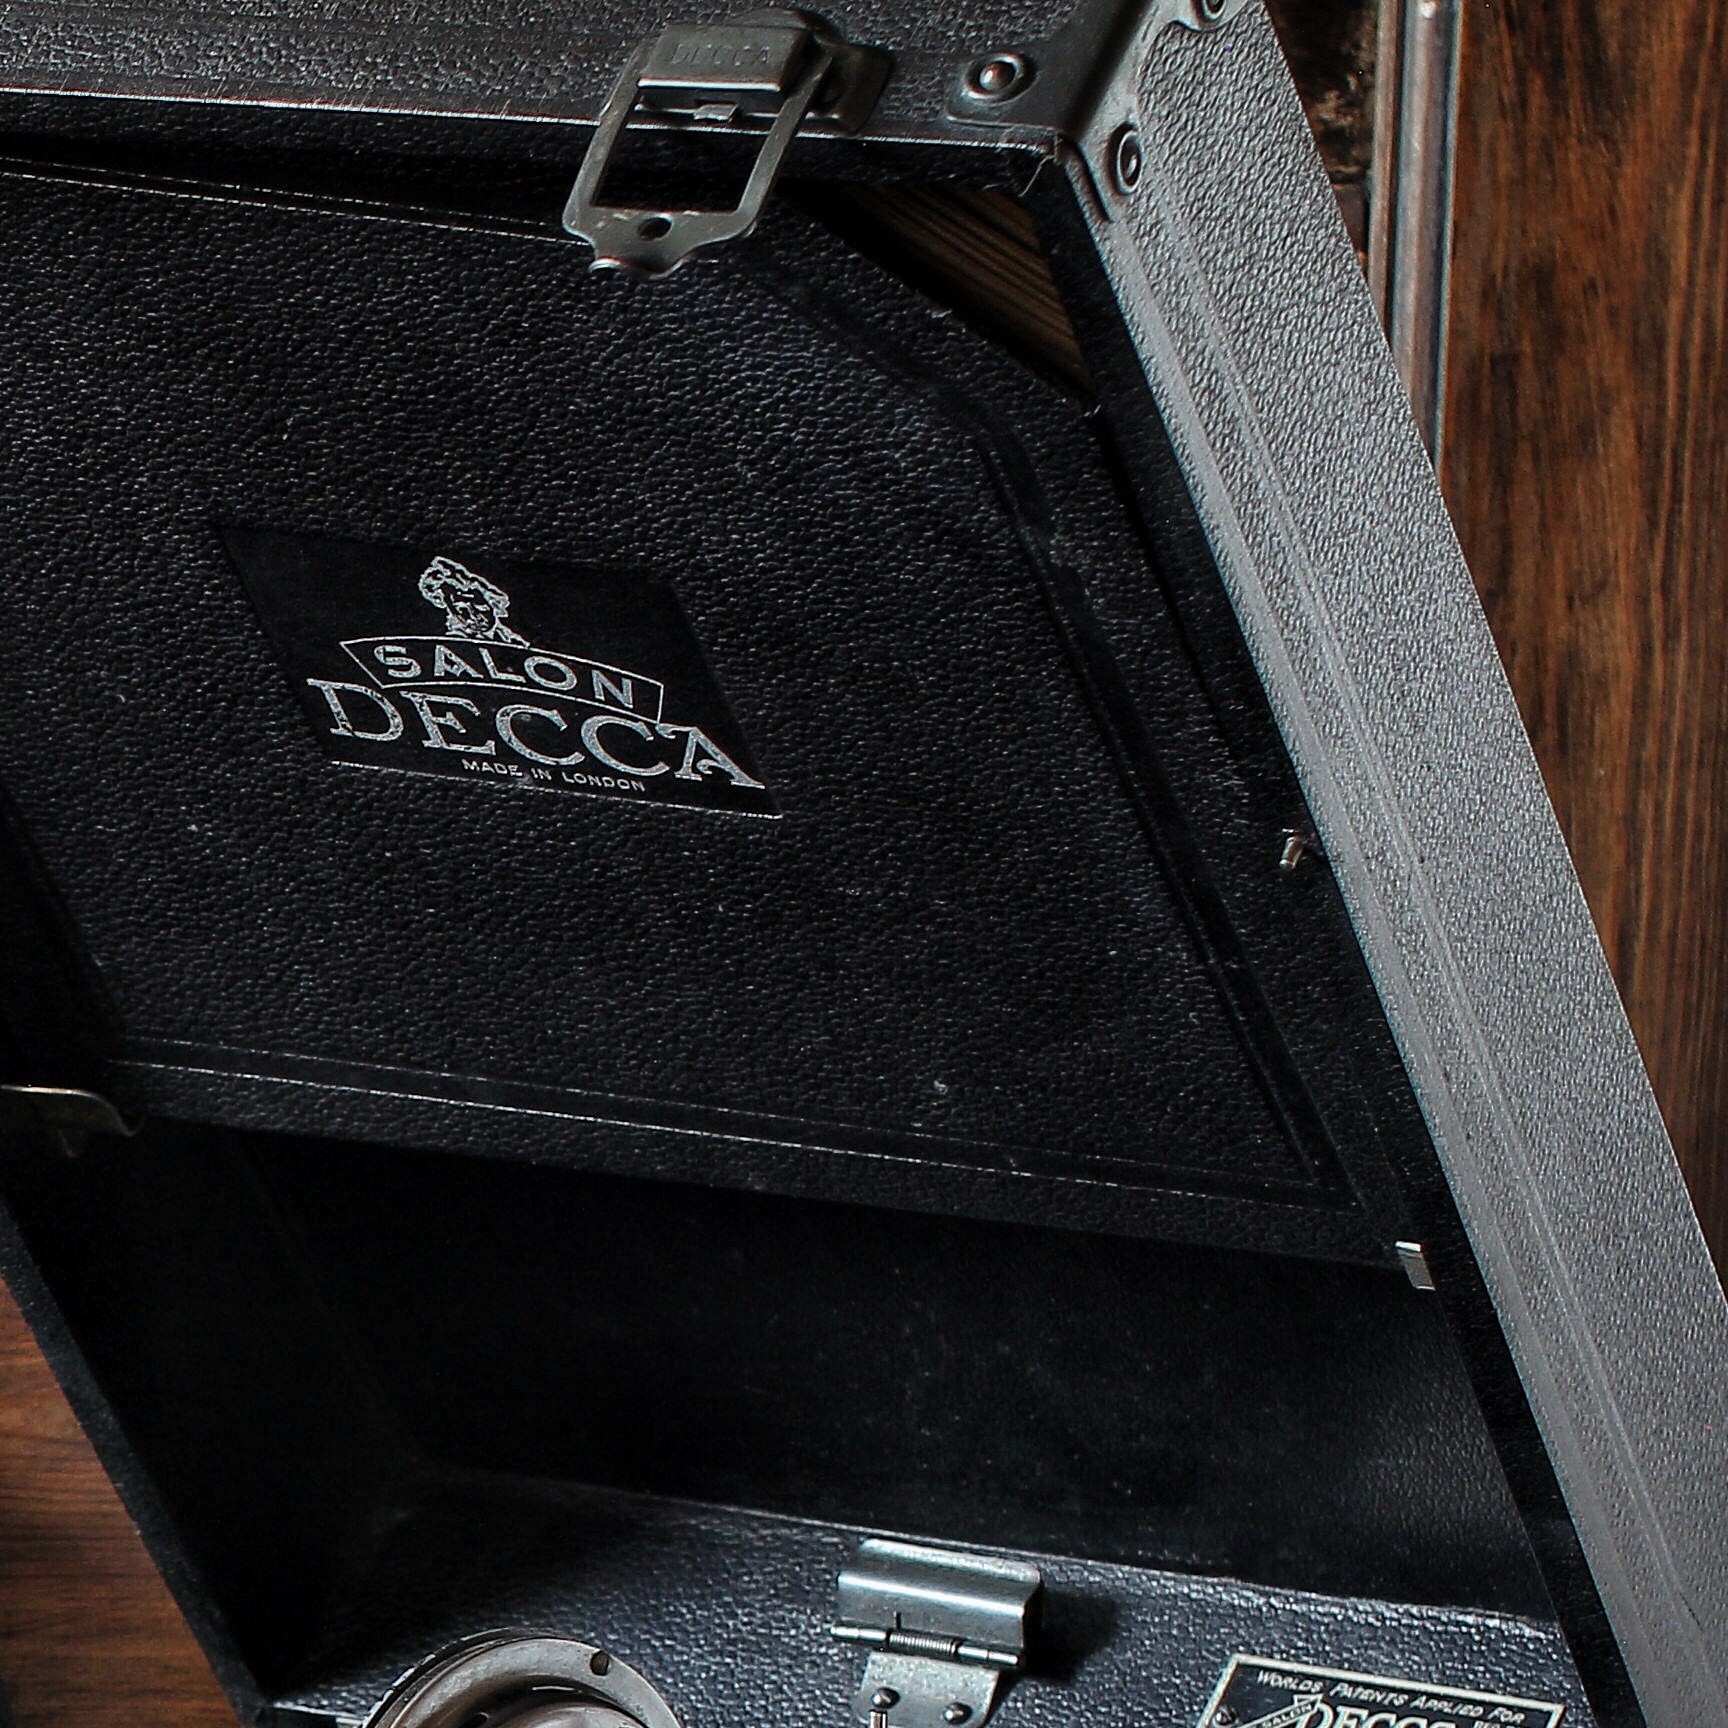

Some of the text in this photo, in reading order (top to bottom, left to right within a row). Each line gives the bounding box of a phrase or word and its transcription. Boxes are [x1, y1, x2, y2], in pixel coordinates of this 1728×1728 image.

[374, 644, 635, 709] SALON
[307, 677, 766, 790] DECCA
[461, 757, 646, 794] MADE IN LONDON
[1329, 1680, 1410, 1707] PATENTS
[1410, 1694, 1485, 1718] APPLIED
[1488, 1706, 1526, 1724] FOR
